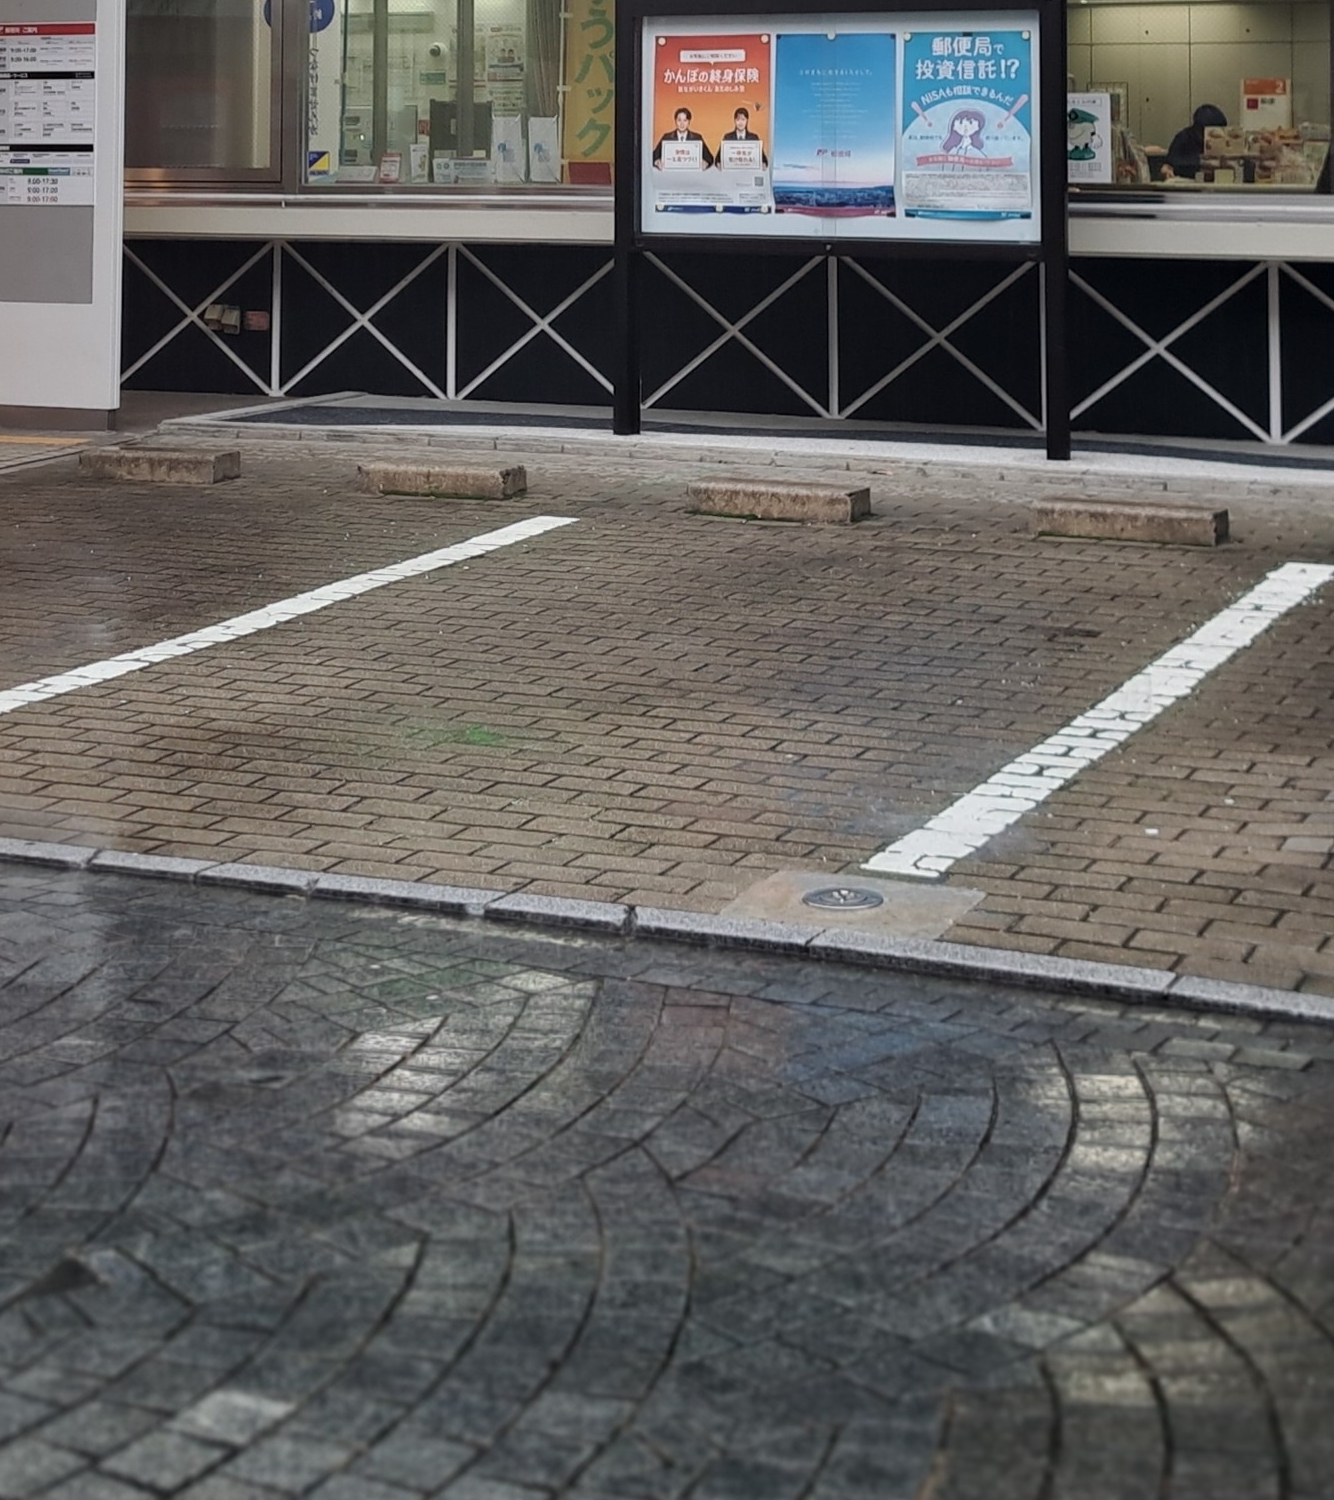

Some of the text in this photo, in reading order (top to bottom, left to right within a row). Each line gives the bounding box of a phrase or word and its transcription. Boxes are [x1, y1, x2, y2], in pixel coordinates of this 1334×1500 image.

[931, 36, 1004, 57] 郵便局で
[663, 67, 760, 85] かんぽの終身保険
[1275, 80, 1285, 94] 2
